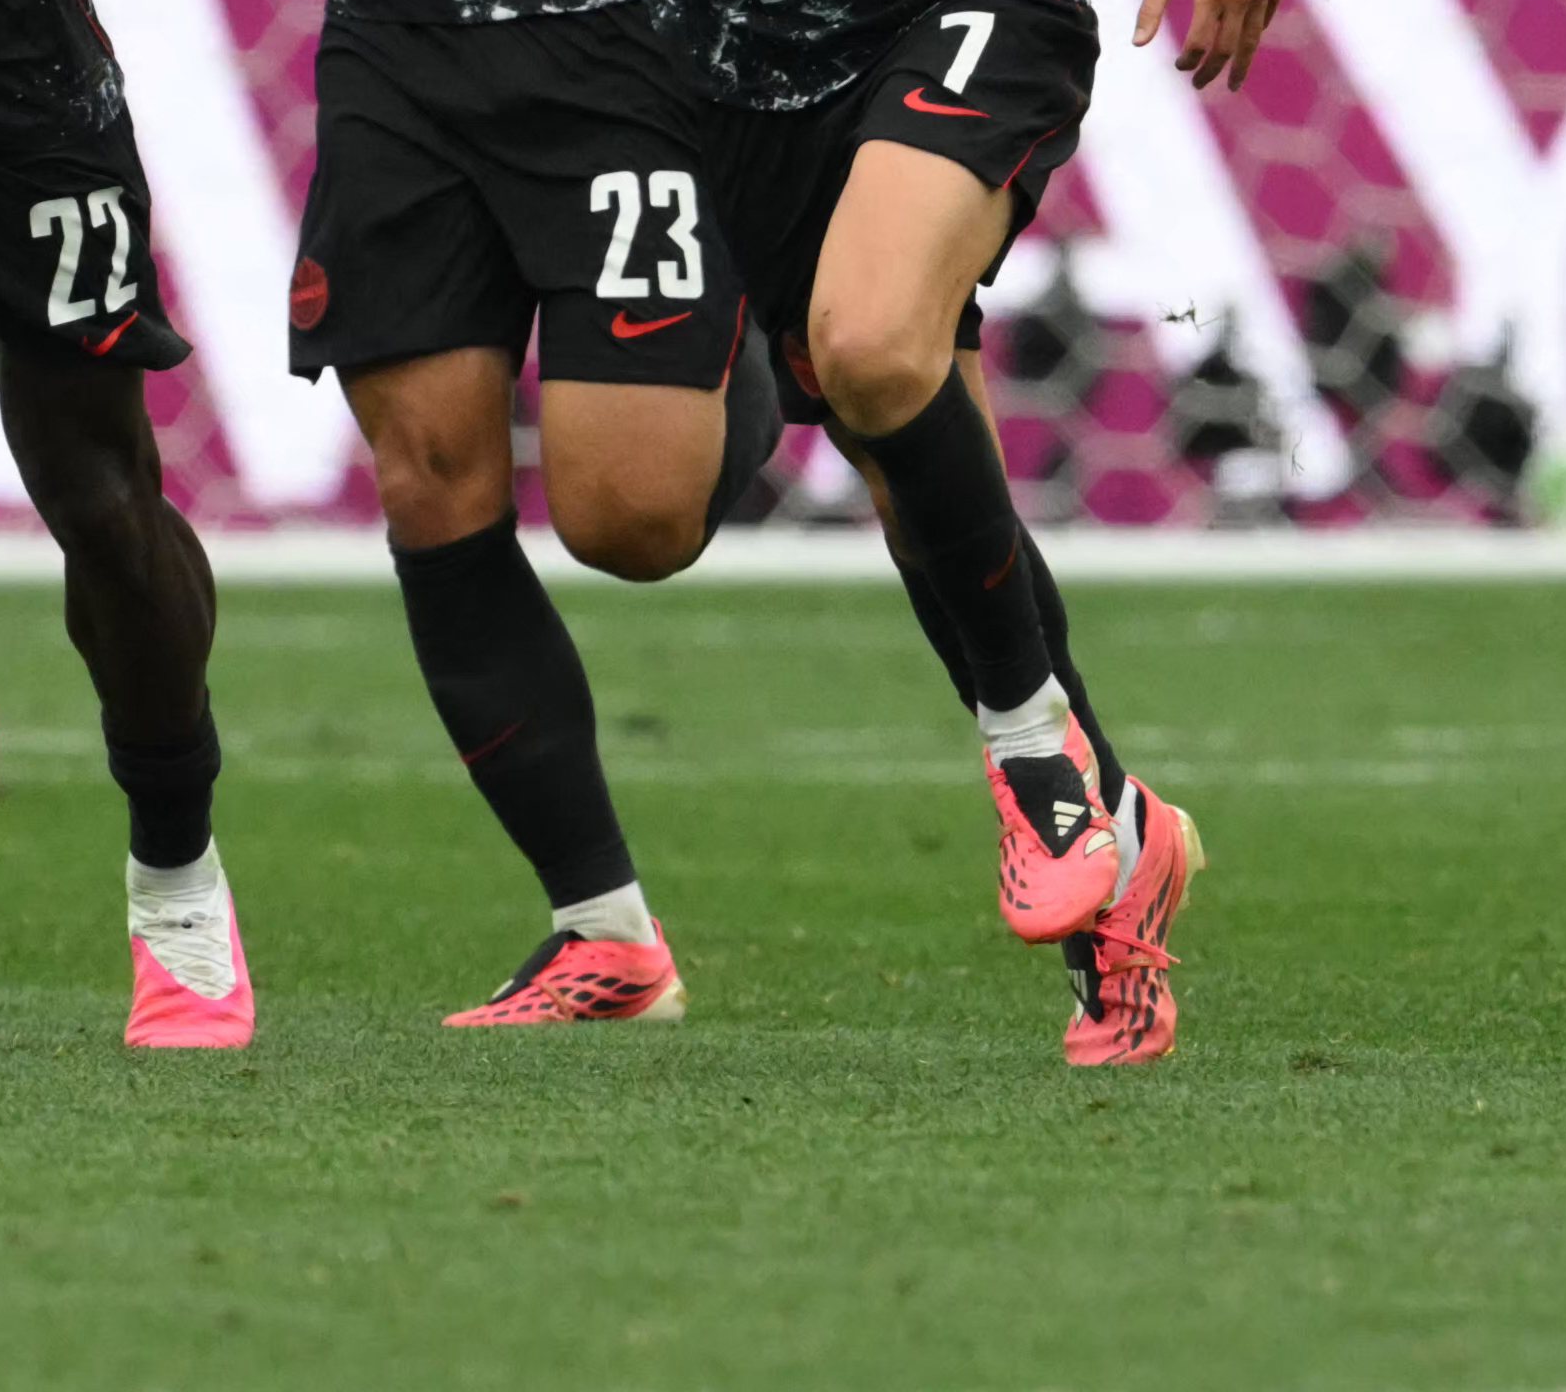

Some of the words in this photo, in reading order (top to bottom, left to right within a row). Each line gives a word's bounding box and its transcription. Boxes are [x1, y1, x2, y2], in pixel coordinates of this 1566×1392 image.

[940, 9, 996, 95] 7
[29, 183, 140, 327] 22
[589, 169, 705, 300] 23
